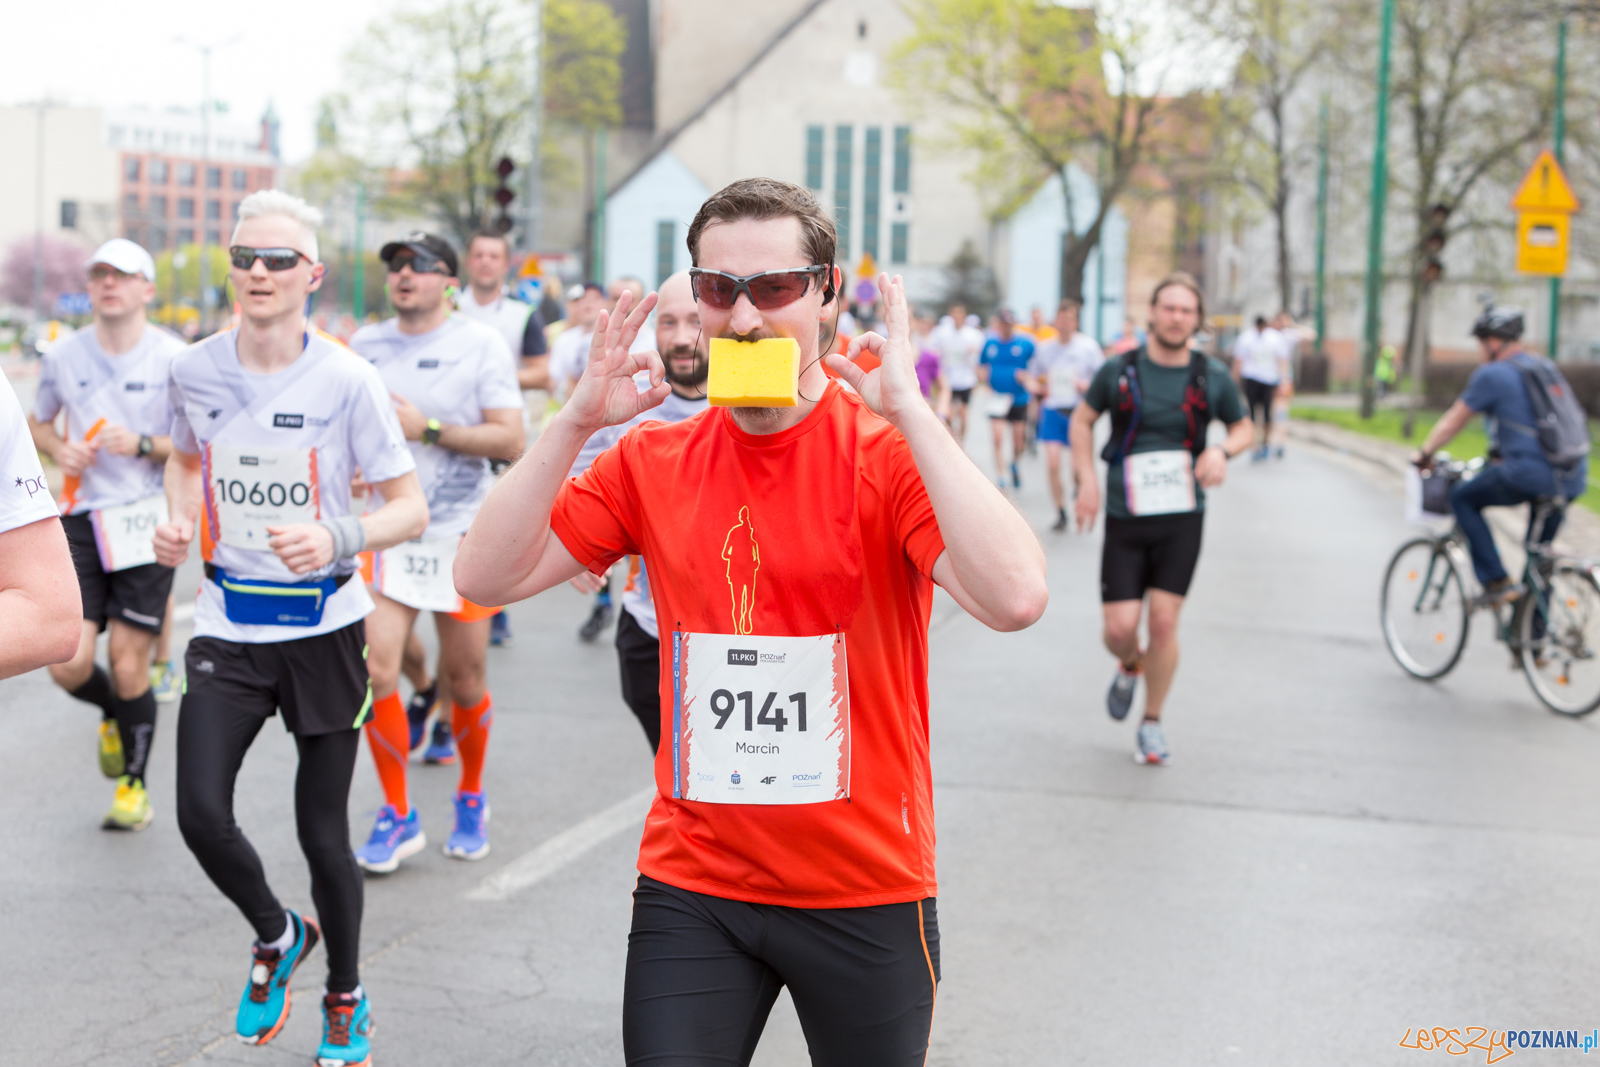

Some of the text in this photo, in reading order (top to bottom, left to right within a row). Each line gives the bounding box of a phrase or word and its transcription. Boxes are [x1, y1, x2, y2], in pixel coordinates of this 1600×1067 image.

[216, 479, 310, 507] 10600
[404, 555, 439, 576] 321
[709, 688, 808, 733] 9141
[735, 741, 781, 755] Marcin
[760, 776, 777, 785] 4F
